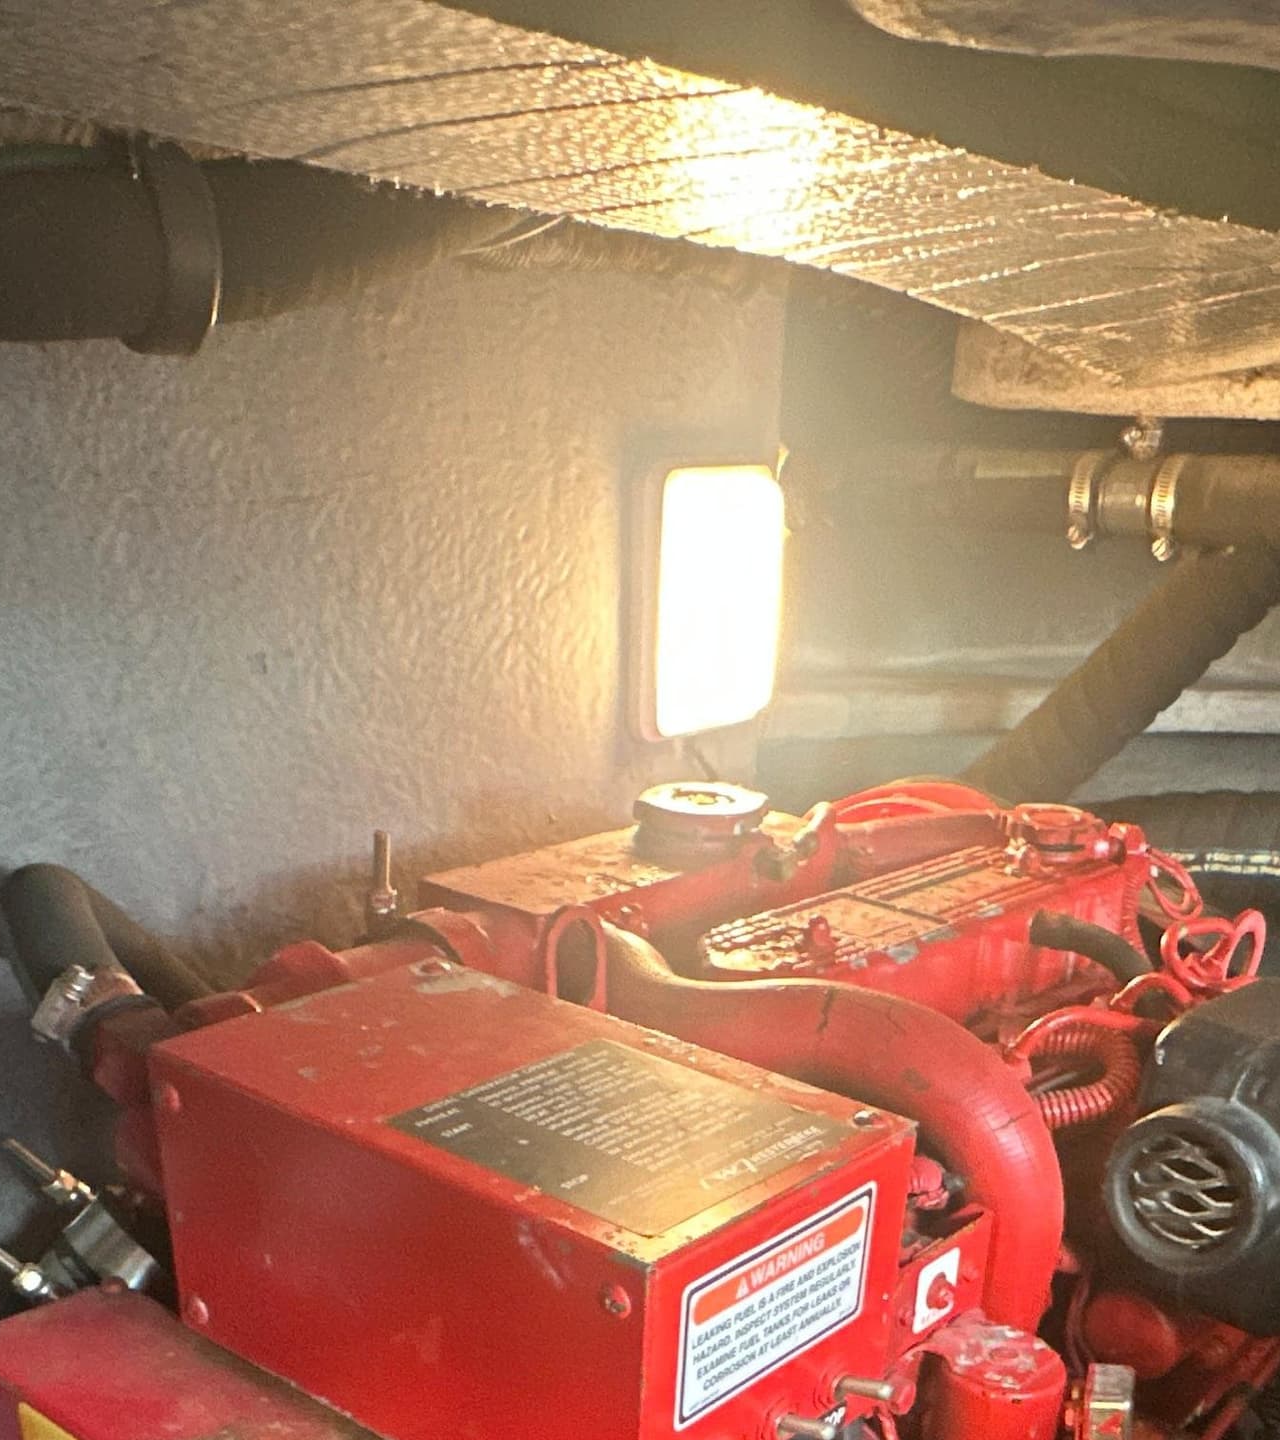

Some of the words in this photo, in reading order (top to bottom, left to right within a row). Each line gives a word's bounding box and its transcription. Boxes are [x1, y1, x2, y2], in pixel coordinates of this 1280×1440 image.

[752, 1231, 826, 1289] WARNING
[691, 1313, 732, 1350] LEAKING
[733, 1300, 756, 1327] FUEL
[758, 1293, 768, 1312] IS
[775, 1278, 795, 1302] FIRE
[797, 1268, 816, 1290] AND
[817, 1240, 862, 1277] EXPLOSION
[696, 1346, 737, 1381] EXAMINE
[738, 1333, 761, 1358] FUEL
[763, 1314, 791, 1344] TANKS
[792, 1302, 809, 1328] FOR
[809, 1286, 838, 1317] LEAKS
[838, 1276, 852, 1300] OR
[734, 1313, 772, 1341] INSPECT
[772, 1289, 808, 1318] SYSTEM
[702, 1352, 757, 1391] CORROSION
[757, 1343, 770, 1363] AT
[770, 1323, 798, 1351] LEAST
